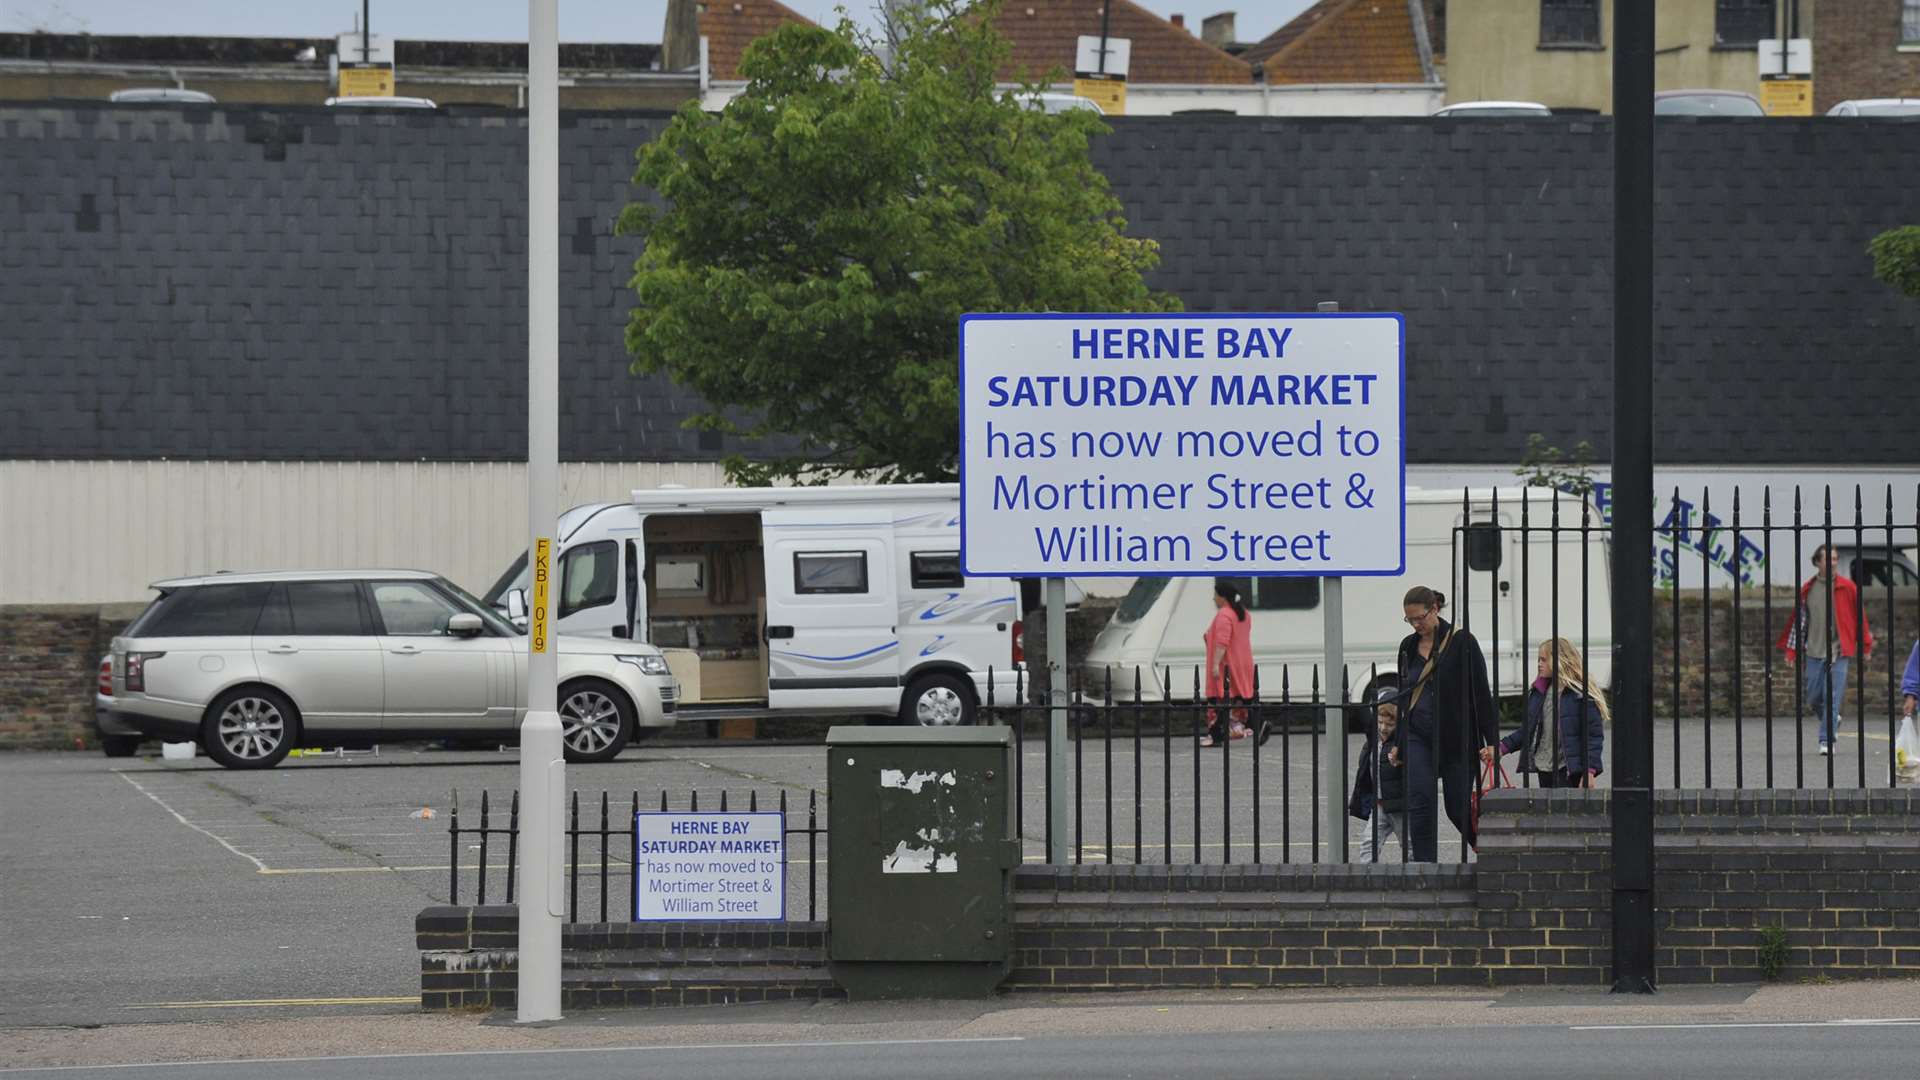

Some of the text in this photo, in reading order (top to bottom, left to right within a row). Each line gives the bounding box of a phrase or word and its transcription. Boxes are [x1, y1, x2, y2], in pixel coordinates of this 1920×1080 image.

[1072, 327, 1293, 360] HERNE BAY
[987, 374, 1378, 408] SATURDAY MARKET
[986, 419, 1380, 459] has now moved to
[993, 472, 1375, 511] Mortimer Street &
[1034, 524, 1331, 563] William Street
[535, 606, 545, 651] 019
[671, 821, 750, 835] HERNE BAY
[641, 840, 780, 854] SATURDAY MARKET
[647, 858, 775, 874] has now moved to
[649, 878, 773, 894] Mortimer Street &
[662, 897, 759, 913] William Street
